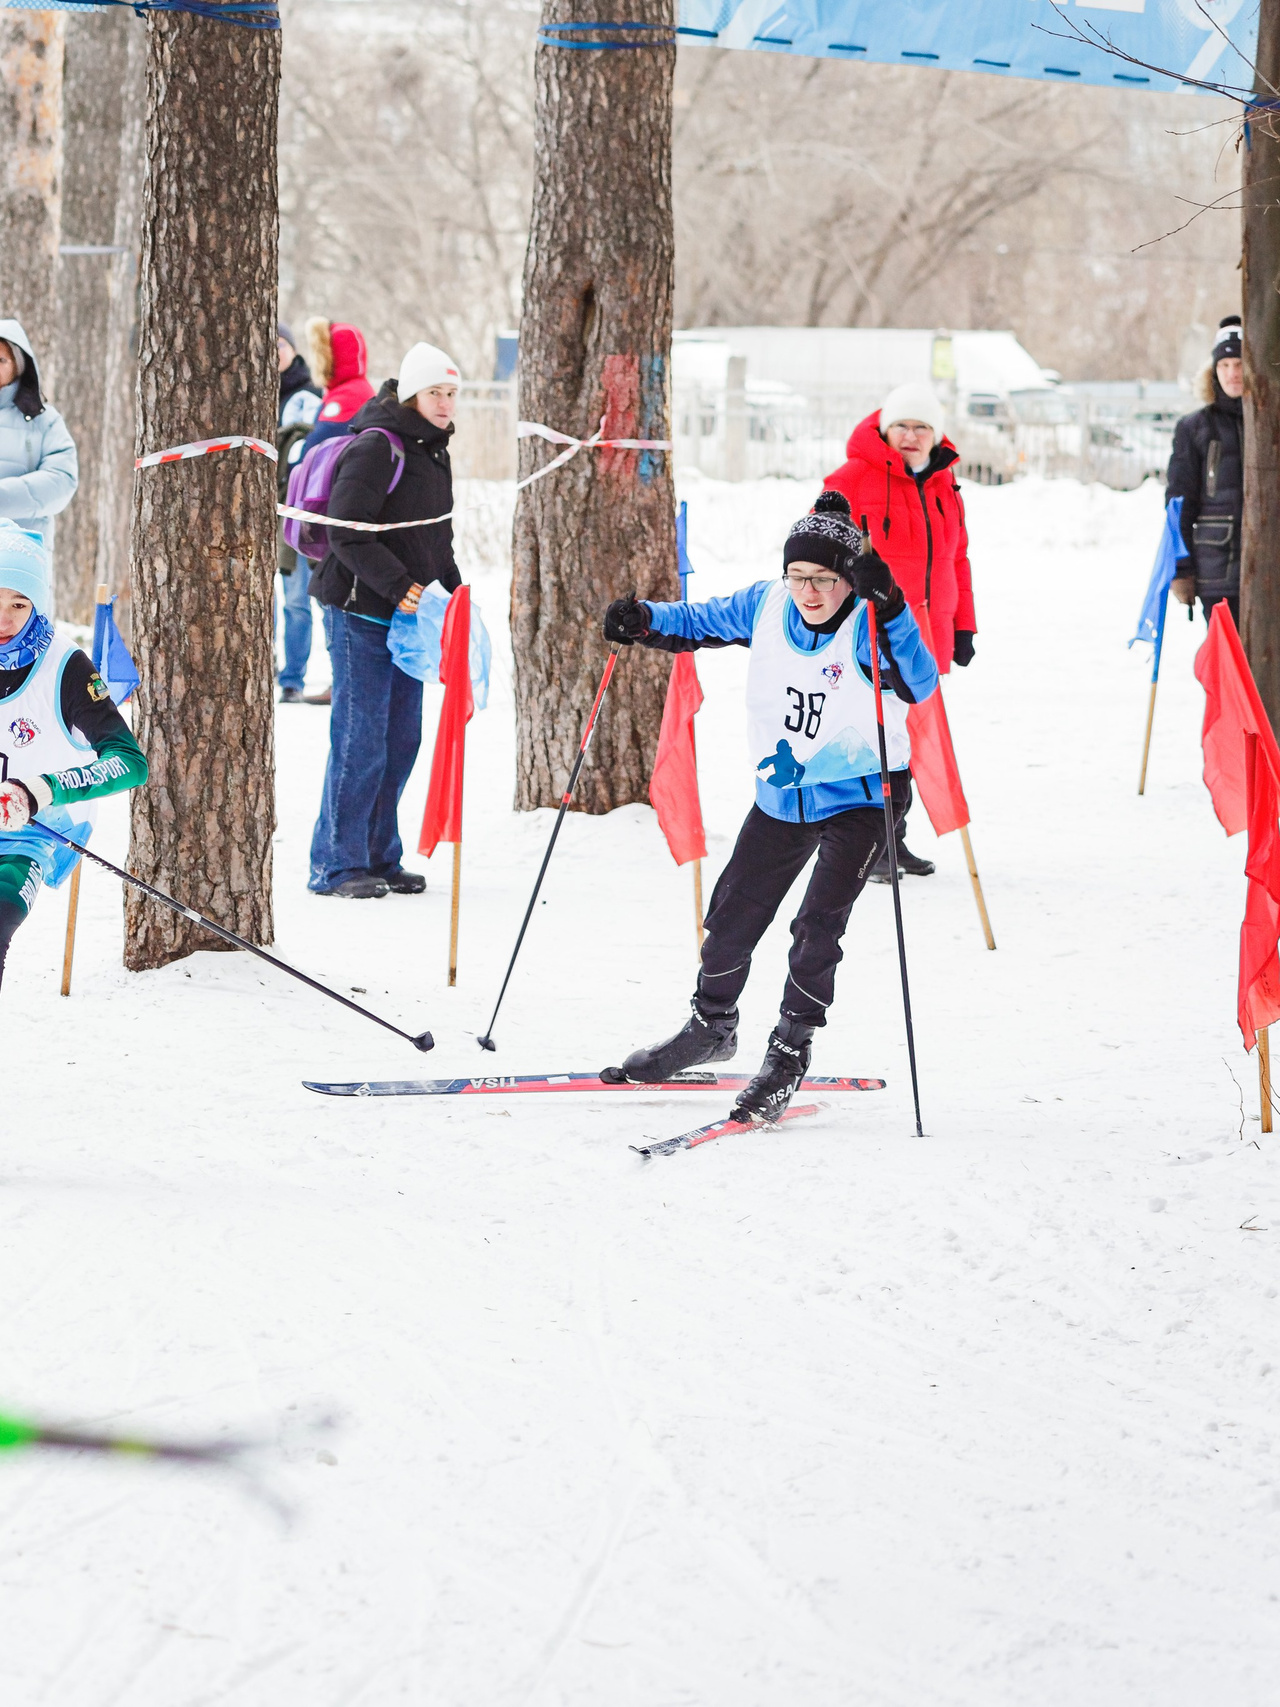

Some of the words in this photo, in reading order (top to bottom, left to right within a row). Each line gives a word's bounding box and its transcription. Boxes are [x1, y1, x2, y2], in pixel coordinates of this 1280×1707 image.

[784, 686, 826, 740] 38
[772, 1038, 802, 1058] TISA
[470, 1076, 519, 1089] TISA
[766, 1082, 795, 1107] TISA
